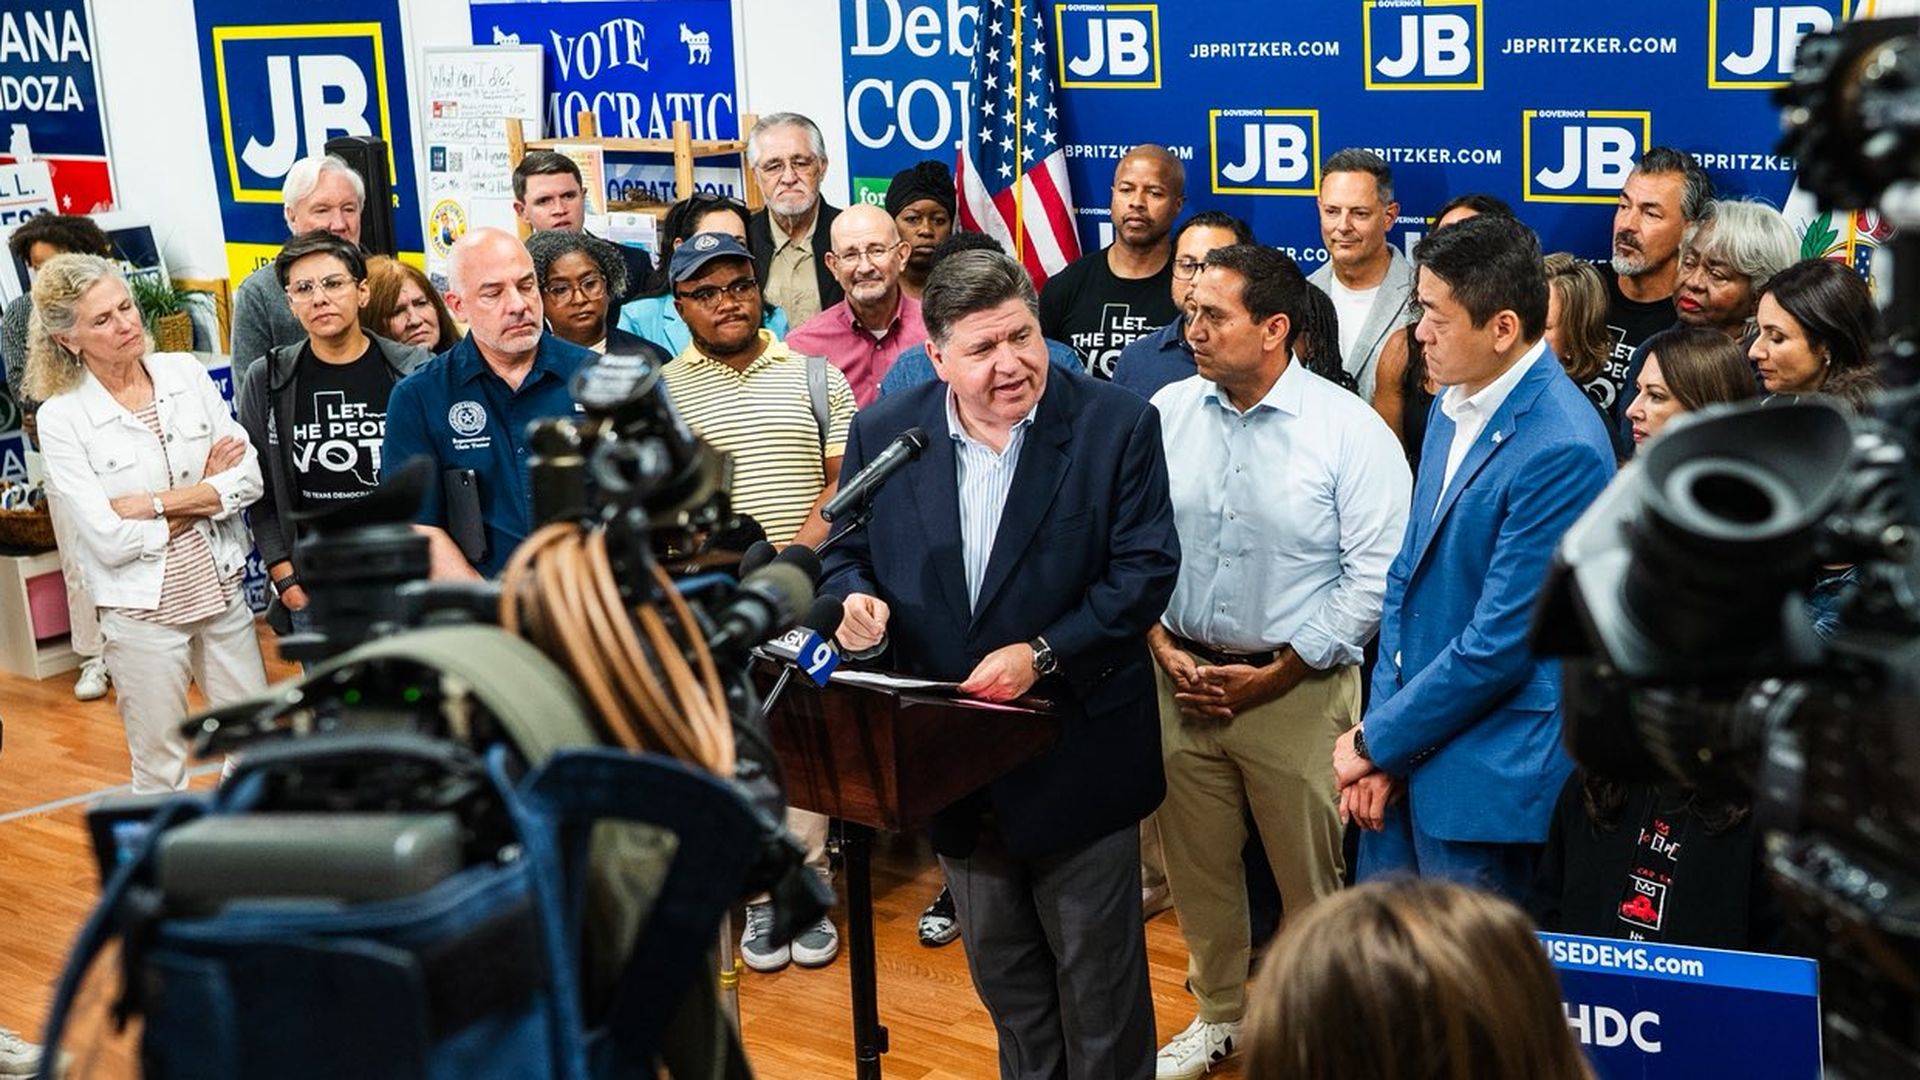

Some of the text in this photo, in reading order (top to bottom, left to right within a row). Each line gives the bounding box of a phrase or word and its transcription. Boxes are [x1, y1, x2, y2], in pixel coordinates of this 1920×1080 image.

[0, 10, 91, 63] ANA
[851, 0, 979, 57] Deb
[1501, 37, 1677, 54] JBPRITZKER.COM
[550, 18, 649, 81] VOTE
[1068, 18, 1149, 77] JB
[1189, 41, 1340, 58] JBPRITZKER.COM
[1376, 14, 1471, 78] JB
[0, 75, 84, 112] DOZA
[241, 55, 373, 179] JB
[847, 78, 970, 150] CO
[1538, 109, 1586, 118] GOVERNOR
[1221, 123, 1309, 182] JB
[1535, 126, 1636, 190] JB
[1079, 207, 1112, 216] GOVERNO
[1071, 332, 1105, 347] THE
[1111, 316, 1147, 331] LET
[327, 403, 368, 419] LET
[293, 423, 322, 440] HE
[292, 439, 384, 473] VOT
[780, 630, 810, 648] GN
[806, 642, 832, 675] 9
